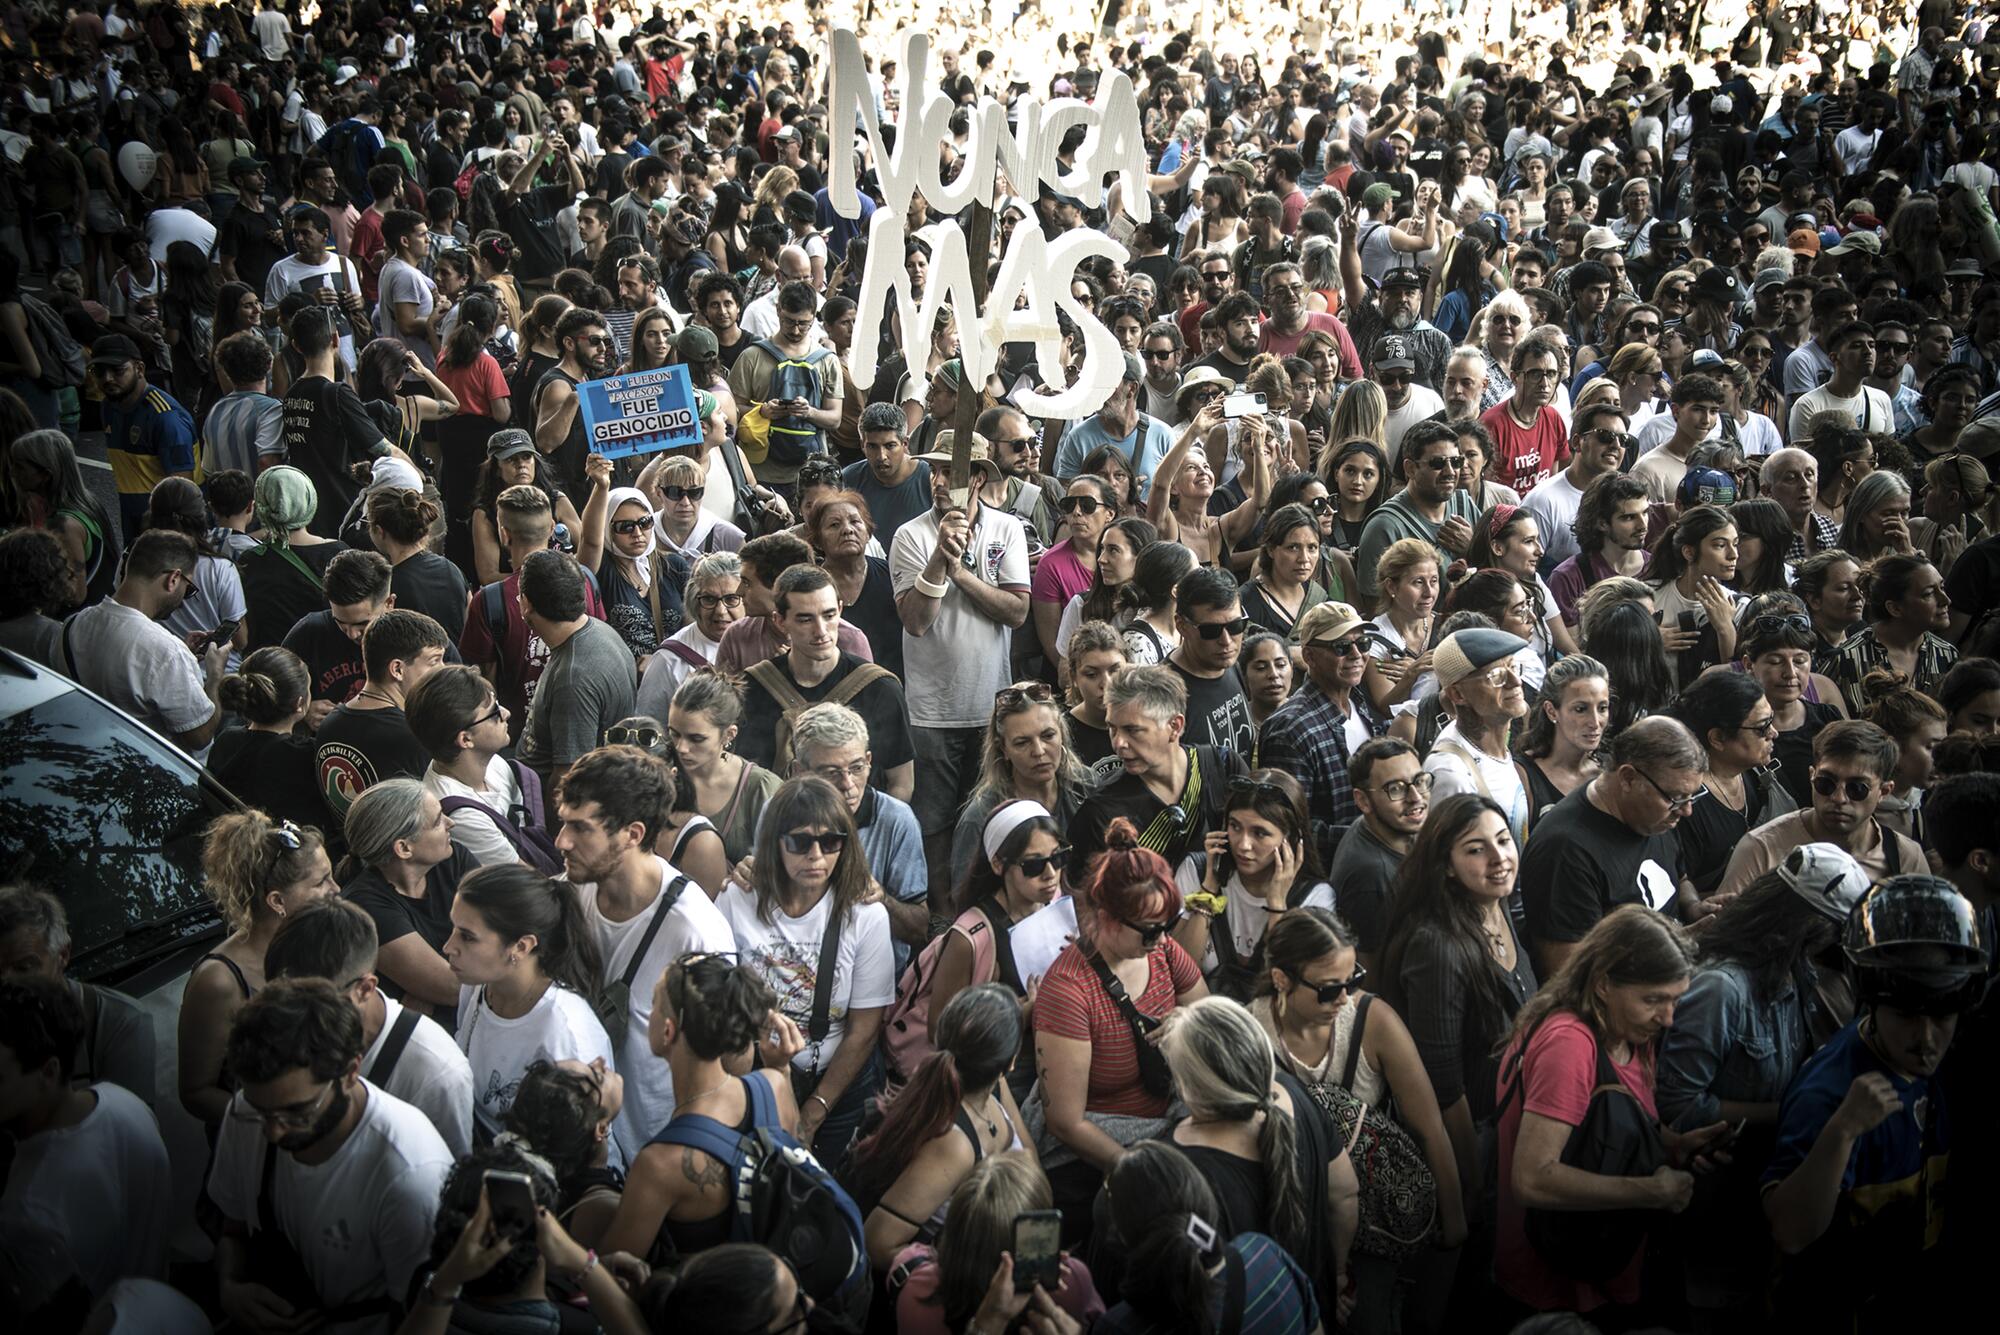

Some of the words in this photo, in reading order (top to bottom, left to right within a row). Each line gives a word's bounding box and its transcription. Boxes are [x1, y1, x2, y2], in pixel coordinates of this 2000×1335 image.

[1385, 345, 1406, 359] 73
[604, 380, 622, 389] NO
[627, 371, 671, 386] FUERON
[622, 398, 658, 416] FUE
[594, 410, 692, 439] GENOCIDIO
[1515, 447, 1541, 469] más
[1512, 468, 1550, 488] nunca
[1211, 703, 1228, 721] PINK
[319, 745, 363, 767] QUIKSILVER
